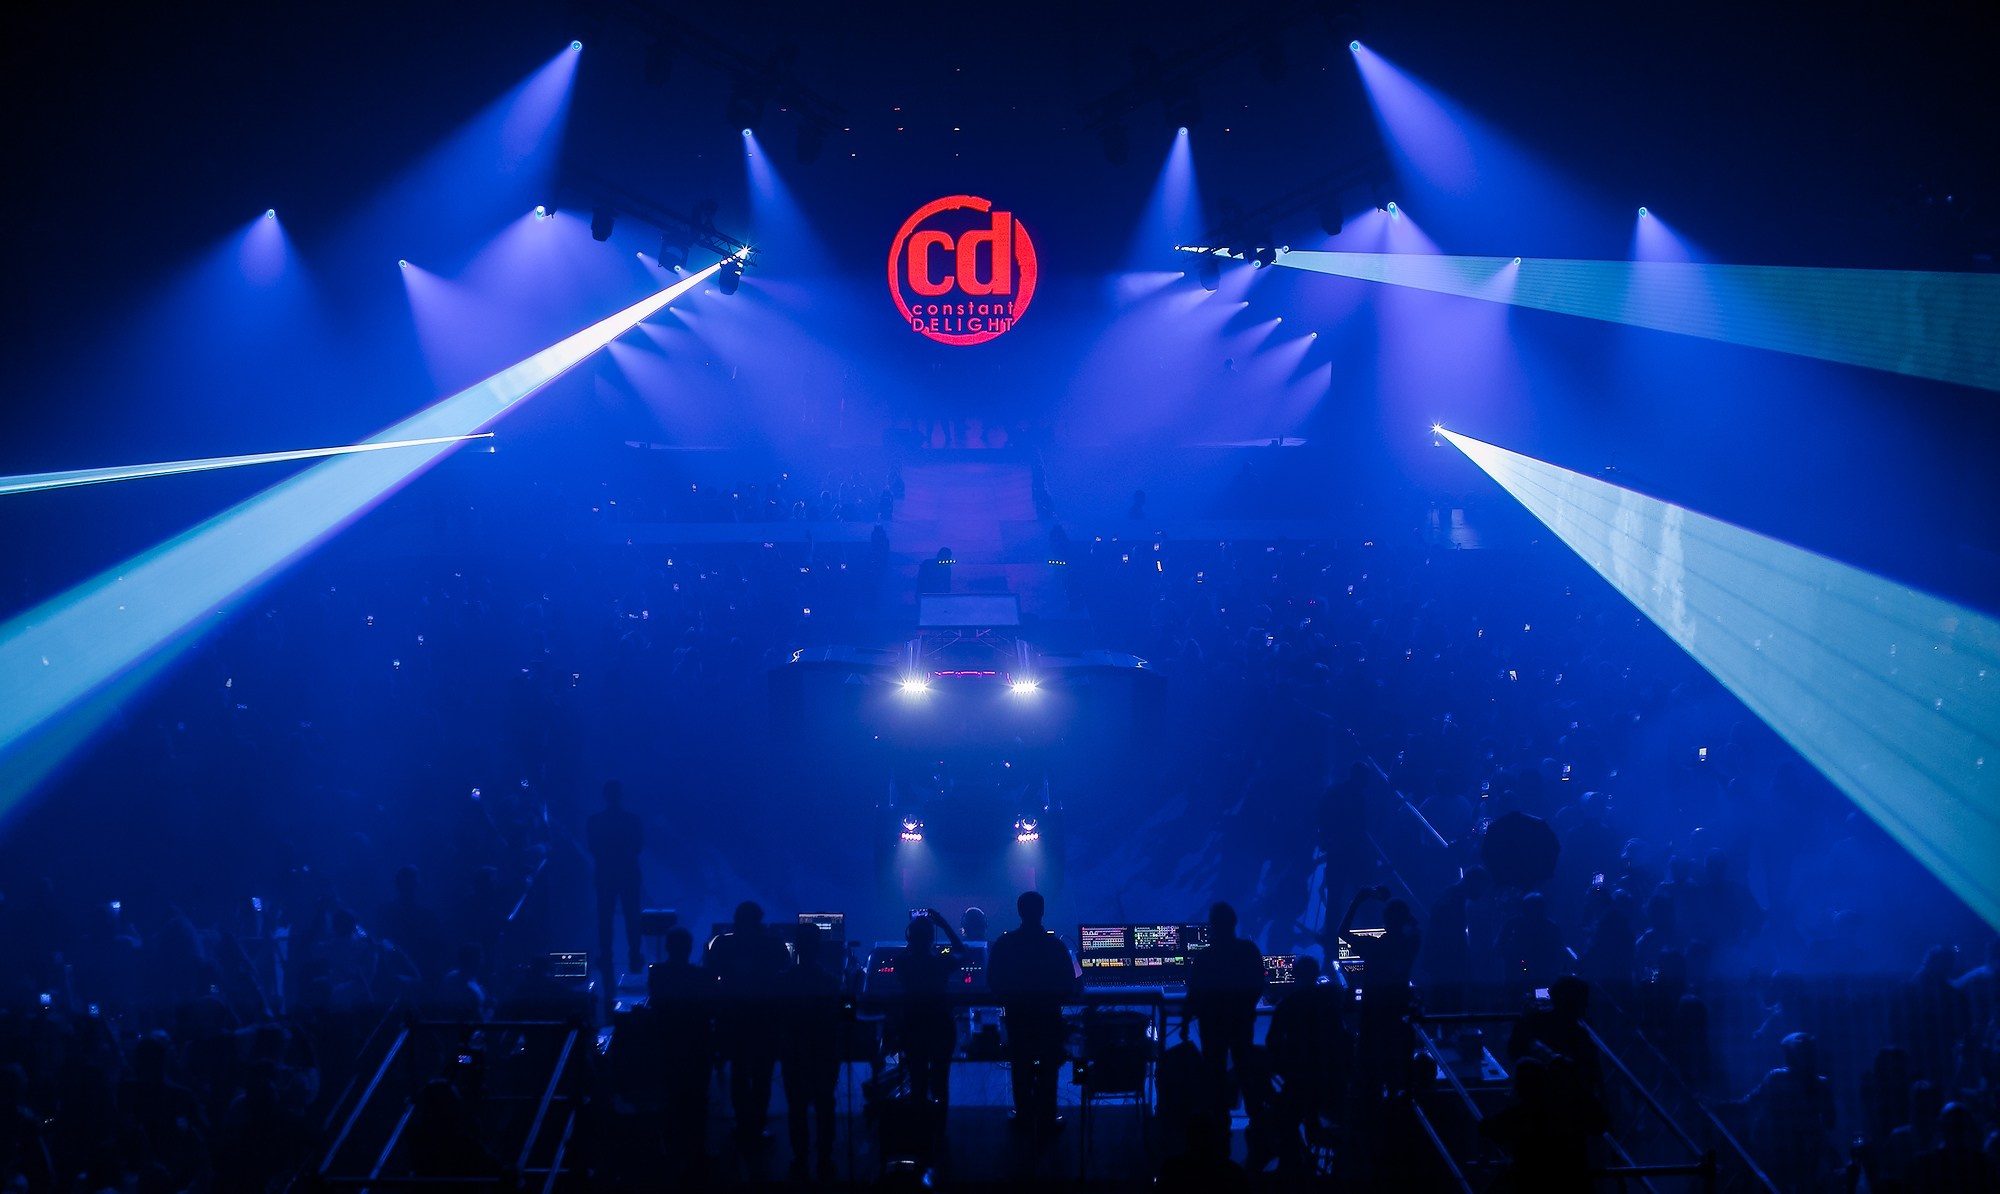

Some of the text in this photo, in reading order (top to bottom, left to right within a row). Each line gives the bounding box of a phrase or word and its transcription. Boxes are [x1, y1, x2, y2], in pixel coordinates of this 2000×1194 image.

[908, 211, 1011, 296] cd
[912, 302, 1014, 316] constant
[912, 318, 1014, 332] DELIGHT
